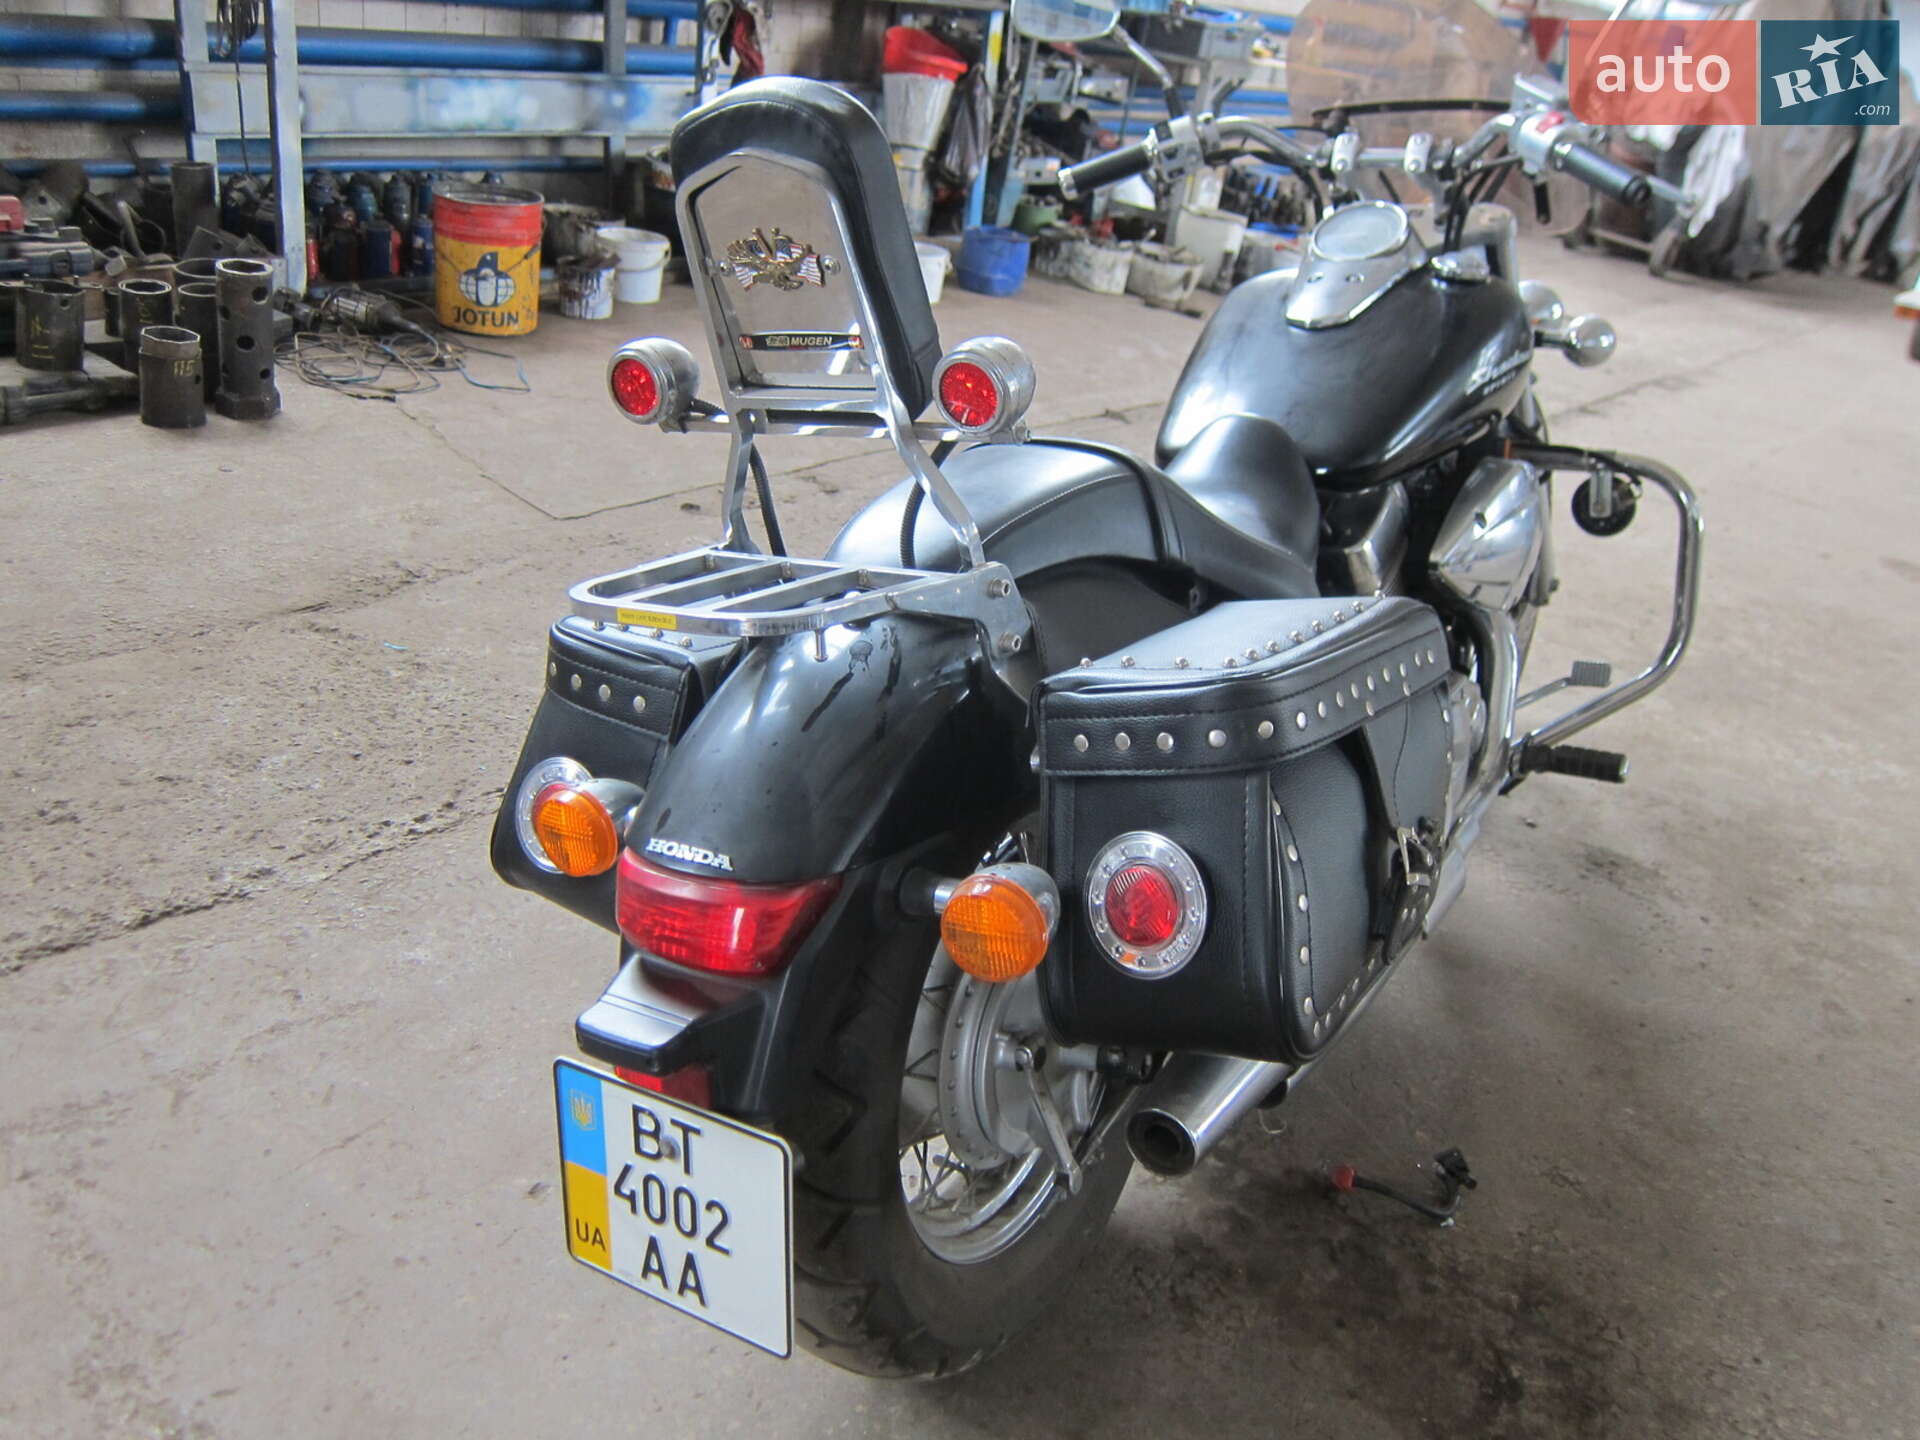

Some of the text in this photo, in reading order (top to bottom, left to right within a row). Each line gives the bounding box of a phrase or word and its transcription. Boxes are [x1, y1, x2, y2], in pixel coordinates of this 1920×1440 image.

[450, 306, 519, 328] JOTUN
[791, 336, 832, 346] MUGEN
[645, 837, 734, 872] HONDA
[631, 1103, 703, 1177] BT
[613, 1162, 732, 1257] 4002
[575, 1217, 607, 1252] UA
[641, 1234, 708, 1308] AA
